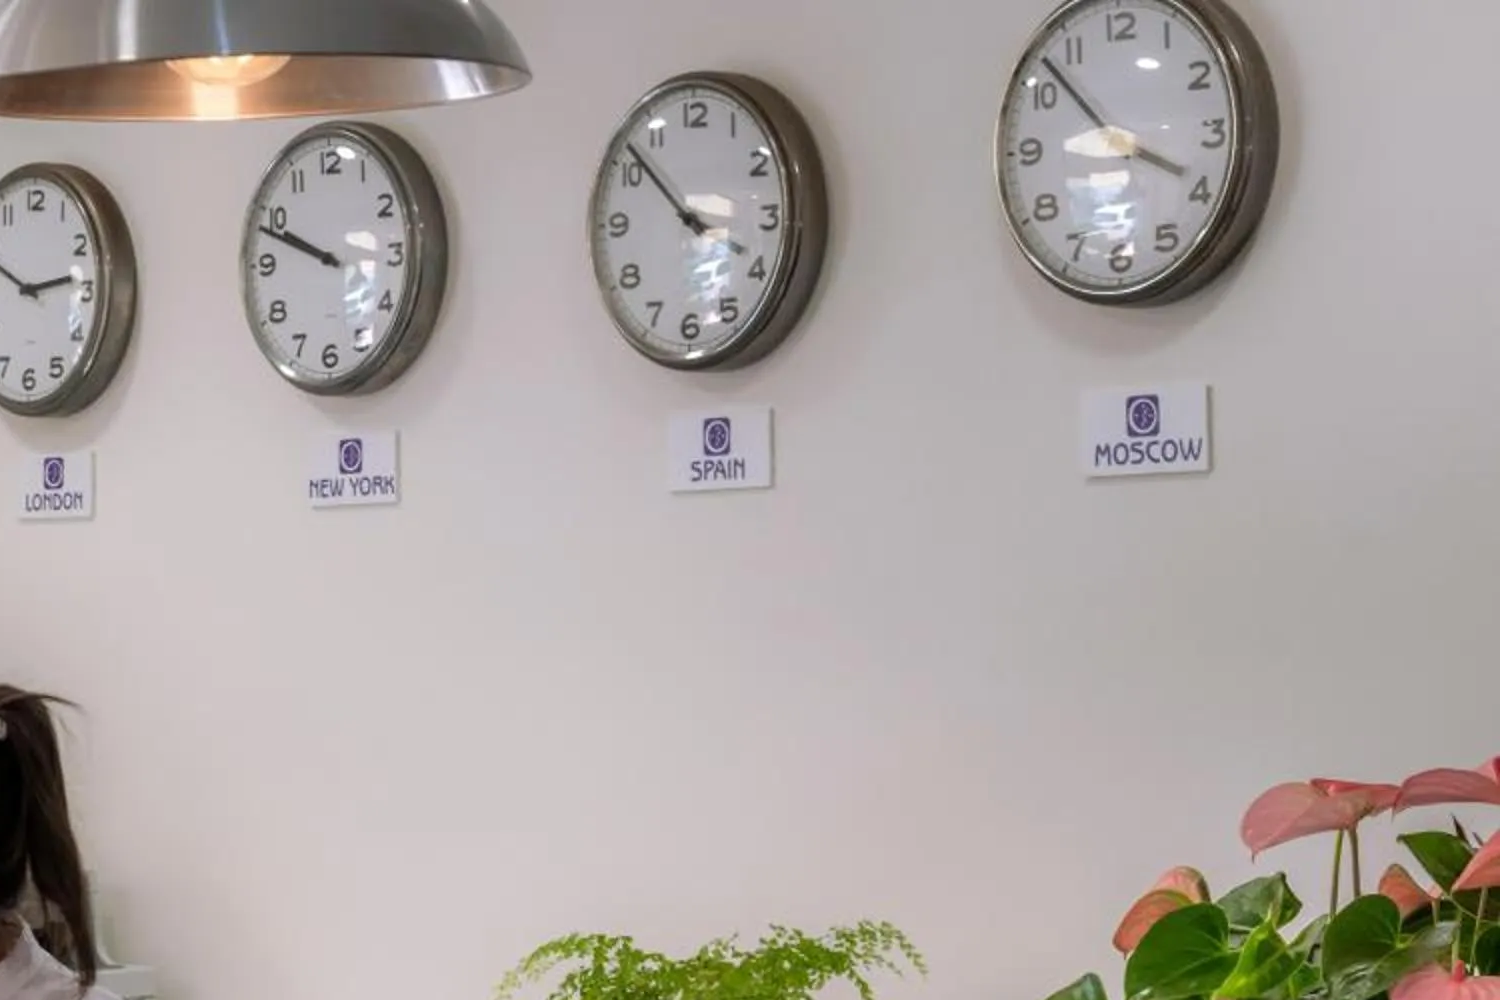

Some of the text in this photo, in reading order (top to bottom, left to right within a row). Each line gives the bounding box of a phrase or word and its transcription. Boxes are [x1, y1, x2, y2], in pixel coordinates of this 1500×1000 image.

[1106, 12, 1136, 42] 12
[1066, 37, 1082, 65] 11
[1188, 62, 1210, 90] 2
[1033, 82, 1057, 110] 10
[684, 102, 708, 128] 12
[650, 127, 663, 148] 11
[1202, 118, 1226, 148] 3
[320, 153, 341, 175] 12
[750, 151, 769, 177] 2
[1019, 138, 1043, 166] 9
[292, 170, 304, 192] 11
[622, 163, 642, 187] 10
[27, 190, 45, 211] 12
[1188, 176, 1212, 204] 4
[3, 205, 13, 226] 11
[377, 194, 394, 218] 2
[759, 204, 779, 231] 3
[1034, 194, 1058, 222] 8
[269, 207, 287, 231] 10
[609, 212, 629, 237] 9
[74, 234, 87, 256] 2
[1066, 234, 1088, 262] 7
[1154, 224, 1179, 252] 5
[259, 254, 276, 276] 9
[388, 242, 403, 267] 3
[1110, 242, 1133, 272] 6
[620, 264, 640, 289] 8
[748, 255, 766, 282] 4
[81, 280, 93, 302] 3
[378, 289, 394, 312] 4
[269, 300, 287, 323] 8
[646, 302, 664, 326] 7
[720, 298, 738, 323] 5
[680, 314, 700, 340] 6
[292, 334, 307, 357] 7
[322, 344, 338, 368] 6
[22, 368, 36, 390] 6
[49, 357, 64, 378] 5
[1094, 437, 1203, 467] MOSCOW
[690, 457, 746, 482] SPAIN
[308, 475, 395, 499] NEW YORK
[25, 492, 84, 512] LONDON
